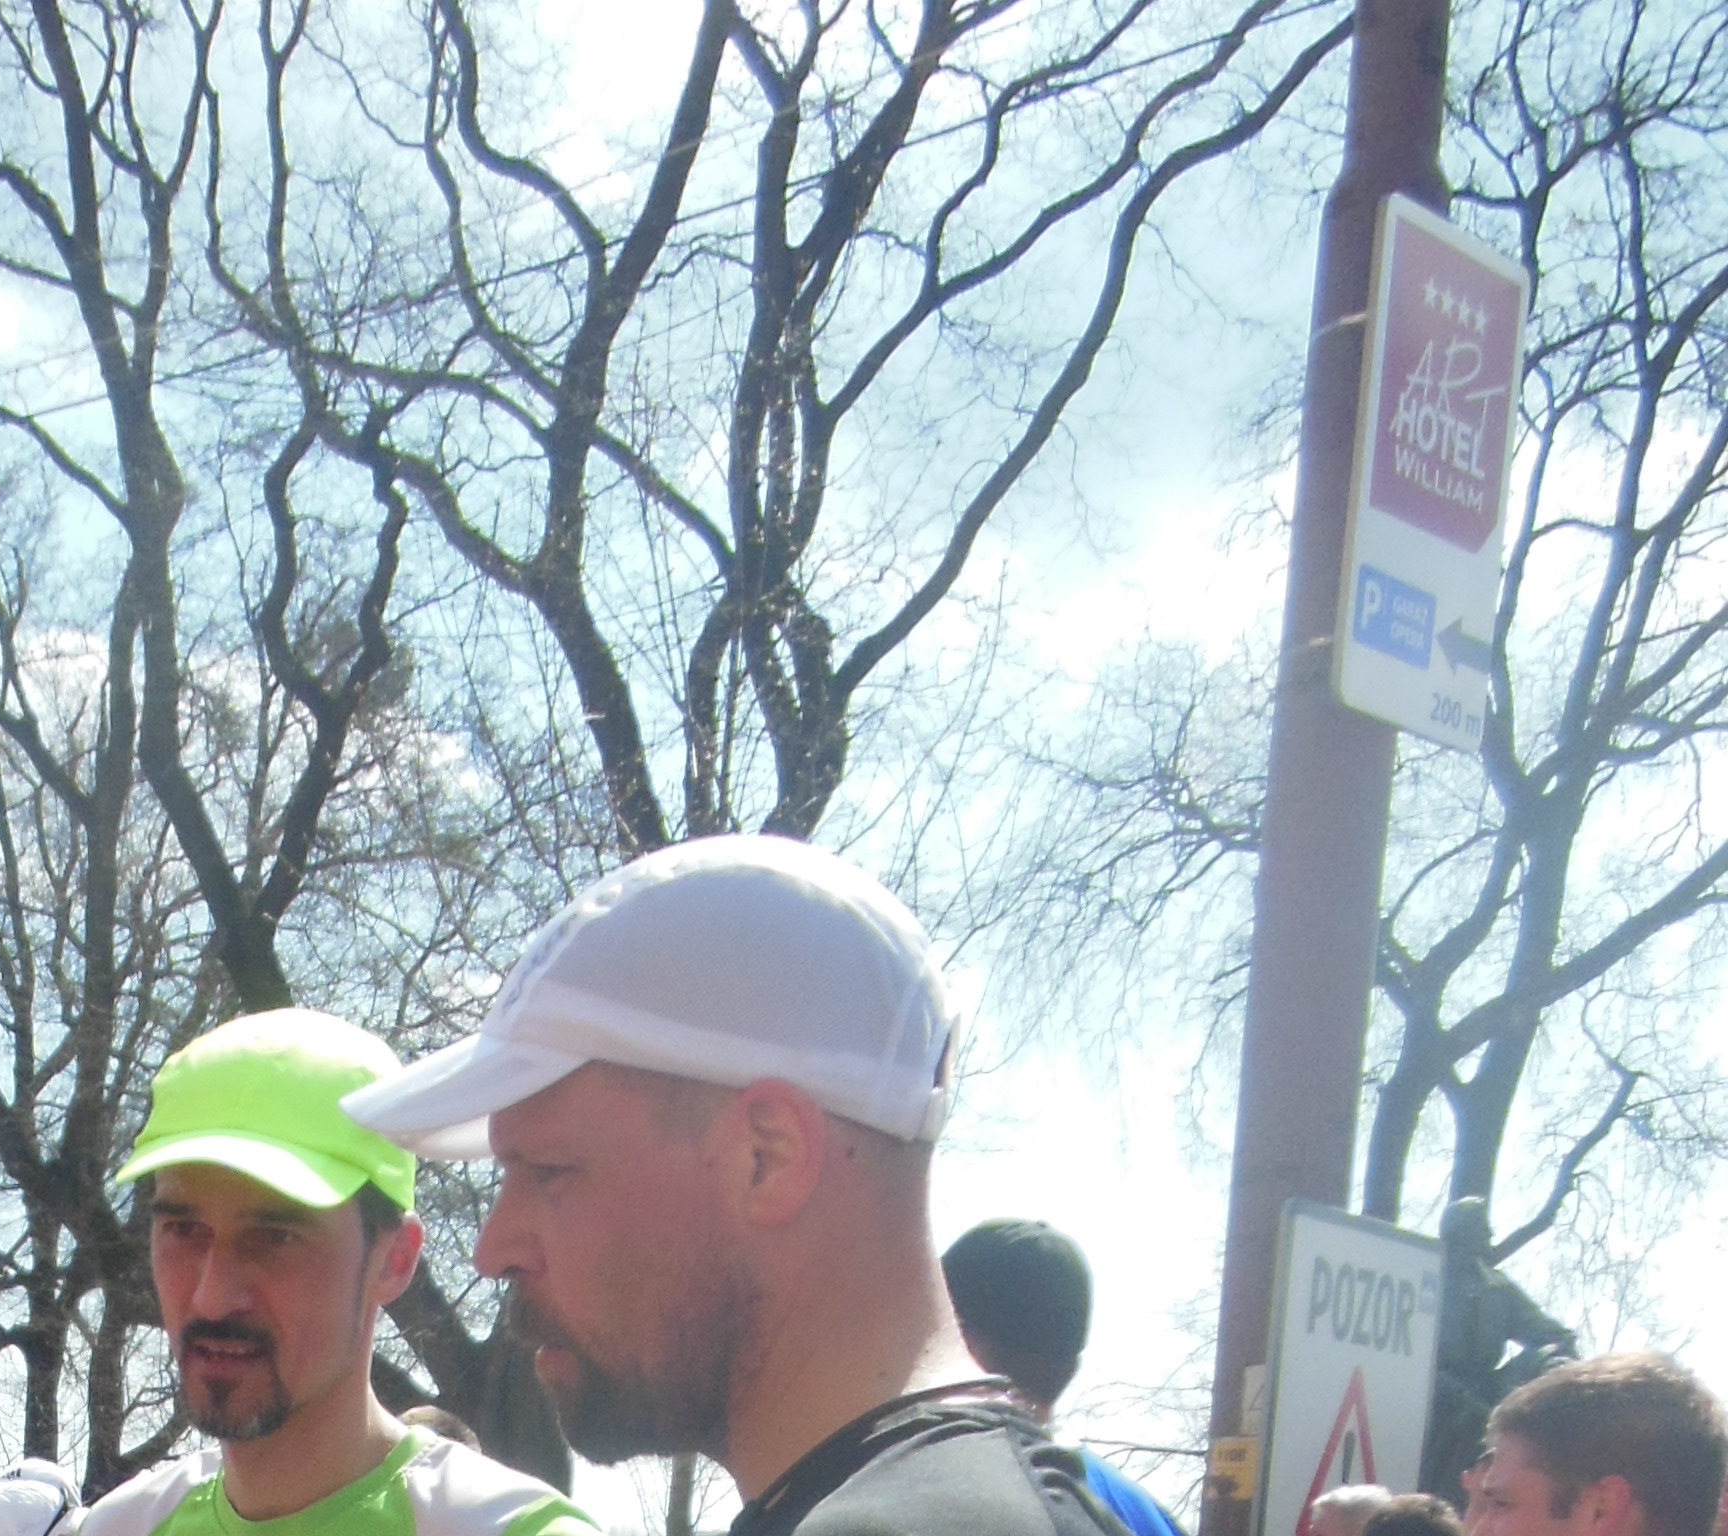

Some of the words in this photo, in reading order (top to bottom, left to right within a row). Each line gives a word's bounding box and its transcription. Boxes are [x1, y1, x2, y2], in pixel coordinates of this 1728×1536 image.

[1389, 336, 1506, 435] ART
[1395, 391, 1485, 481] HOTEL
[1394, 444, 1485, 514] WILLIAM
[1360, 579, 1382, 631] P
[1430, 691, 1462, 730] 200
[1465, 713, 1481, 738] m
[1306, 1255, 1416, 1357] POZOR
